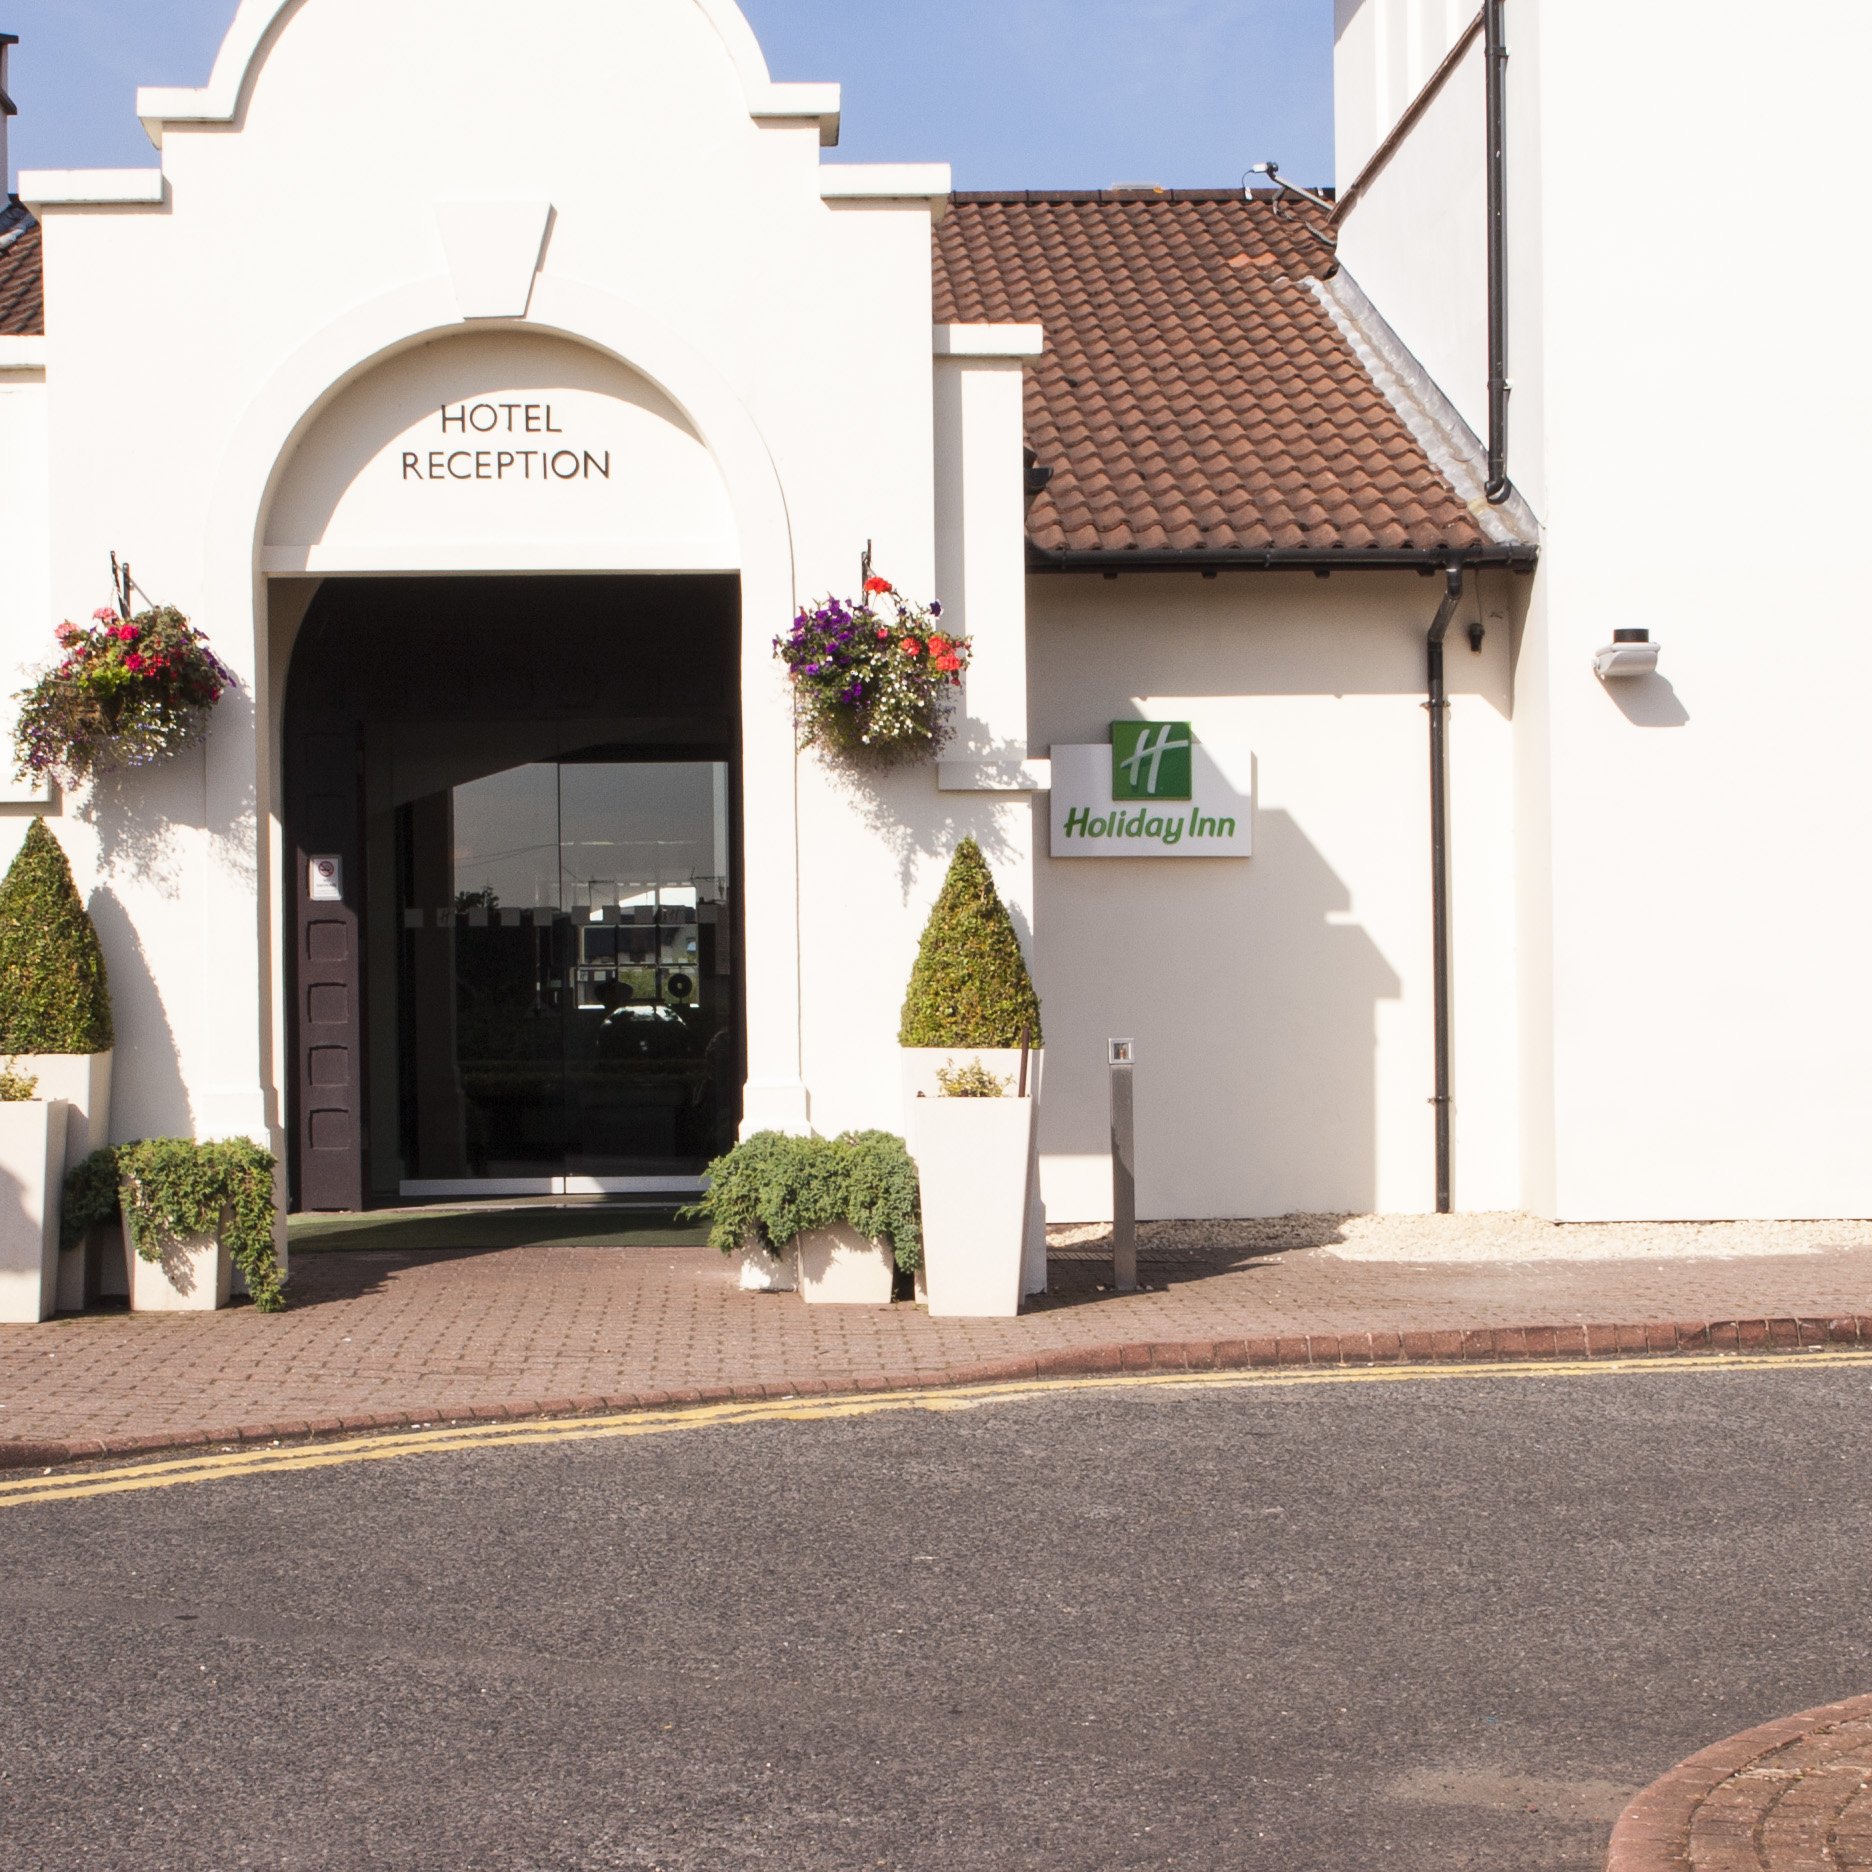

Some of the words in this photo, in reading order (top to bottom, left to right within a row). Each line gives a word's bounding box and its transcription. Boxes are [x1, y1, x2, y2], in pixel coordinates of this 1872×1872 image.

[440, 403, 563, 433] HOTEL
[401, 449, 611, 480] RECEPTION
[1119, 724, 1189, 795] H
[1063, 806, 1185, 845] Holiday
[1188, 806, 1237, 838] Inn
